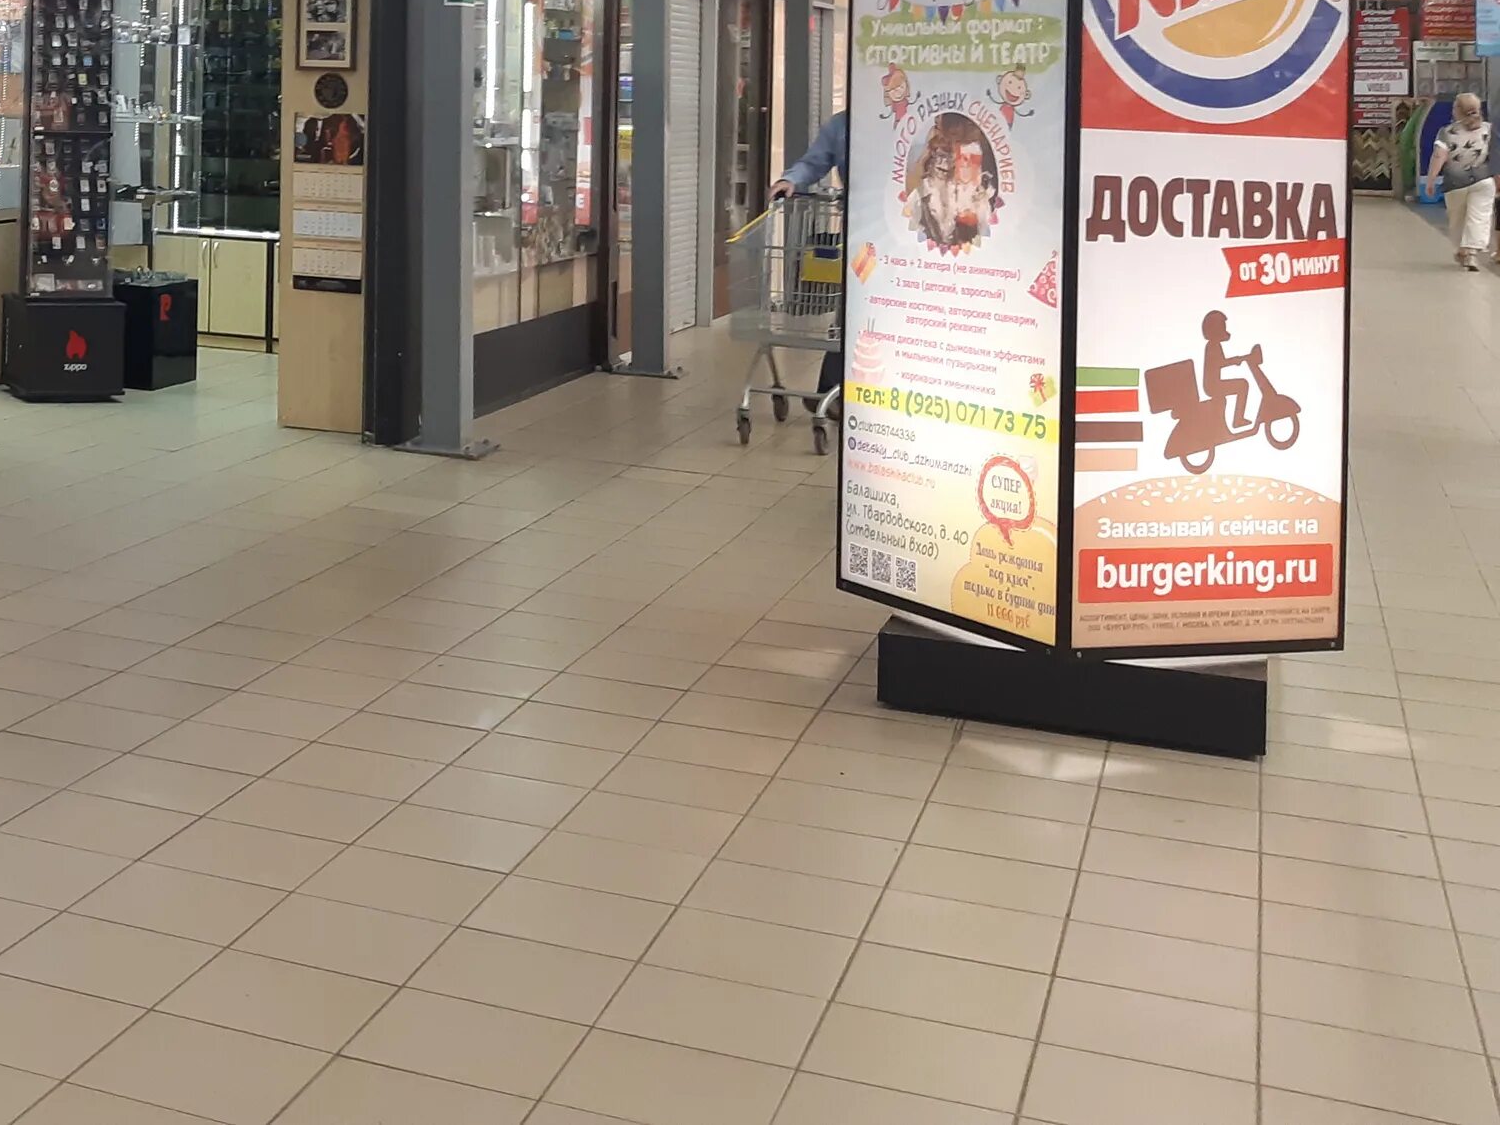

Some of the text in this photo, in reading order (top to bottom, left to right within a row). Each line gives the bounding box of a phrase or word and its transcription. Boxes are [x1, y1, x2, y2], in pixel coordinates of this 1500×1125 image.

[991, 41, 1052, 66] ТЕАТР
[917, 91, 968, 122] РАЗНЫХ
[968, 100, 1016, 194] СЦЕНАРИЕВ
[1085, 175, 1338, 243] ДОСТАВКА
[1258, 252, 1291, 286] 30
[855, 386, 1047, 439] тел: 8 (925) 071 73 75
[991, 474, 1022, 495] СУПЕР
[953, 530, 969, 546] 40
[1096, 514, 1318, 539] Заказывай сейчас на
[1096, 551, 1318, 596] burgerking.ru
